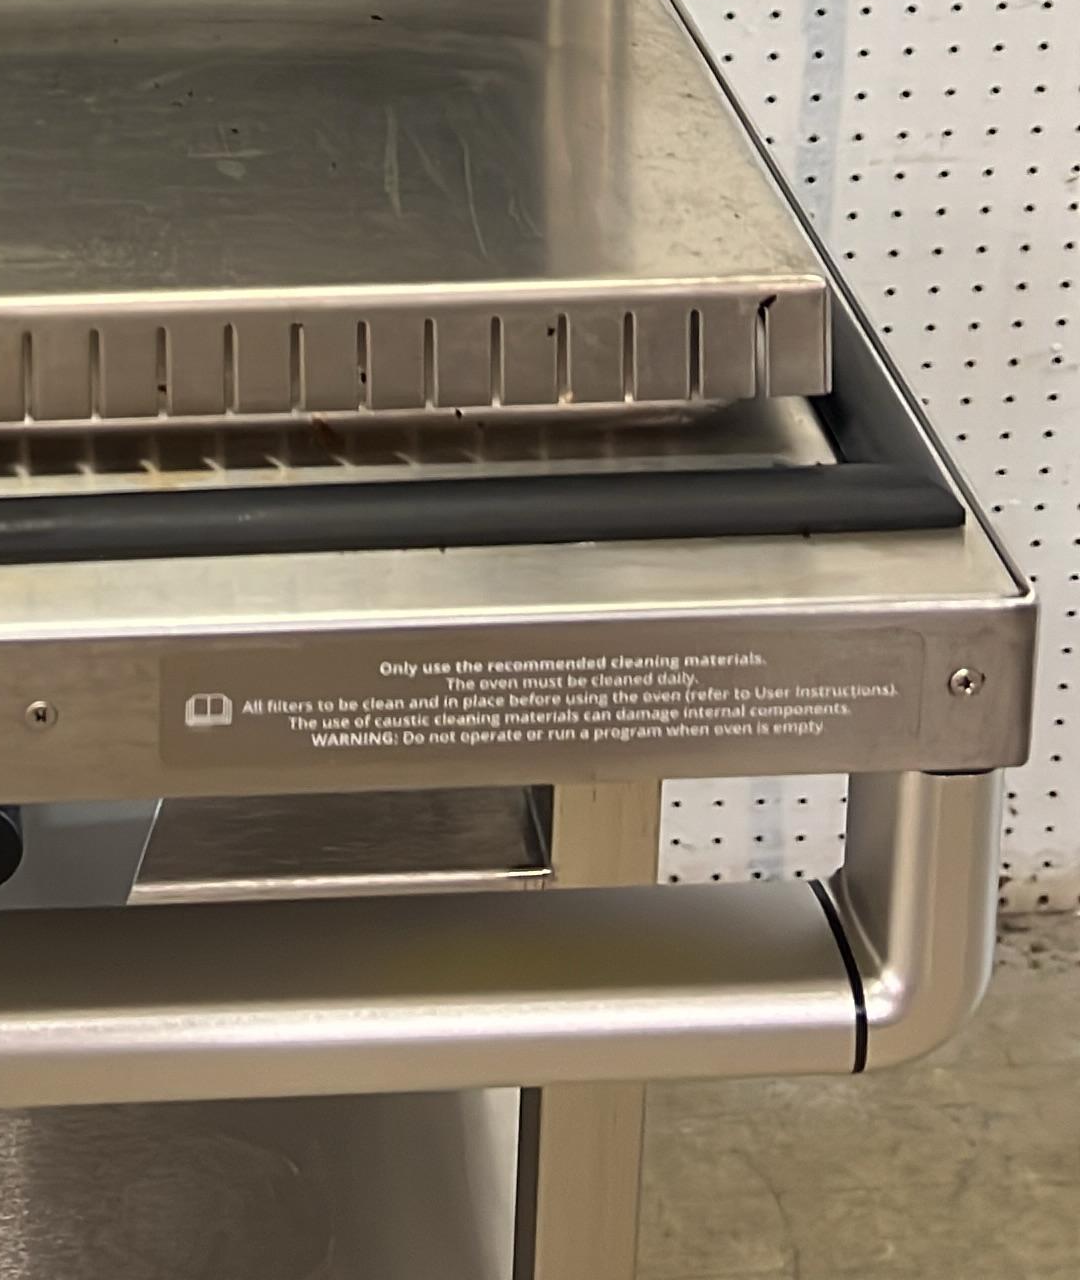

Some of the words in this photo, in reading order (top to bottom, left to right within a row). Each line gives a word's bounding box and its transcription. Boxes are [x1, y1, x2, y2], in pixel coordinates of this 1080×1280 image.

[380, 661, 417, 678] Only
[422, 662, 451, 675] use
[456, 660, 483, 674] the
[487, 656, 607, 673] recommended
[611, 654, 680, 671] cleaning
[684, 651, 767, 667] materials.
[446, 677, 476, 691] The
[480, 677, 518, 690] oven
[523, 676, 563, 689] must
[568, 674, 588, 688] be
[591, 672, 653, 687] cleaned
[657, 671, 699, 688] daily.
[242, 699, 263, 714] All
[267, 698, 313, 714] filters
[318, 699, 334, 713] to
[339, 697, 358, 712] be
[363, 696, 405, 711] clean
[409, 695, 439, 710] and
[443, 695, 459, 709] in
[462, 693, 505, 711] place
[509, 691, 561, 708] before
[566, 691, 609, 708] using
[612, 689, 638, 704] the
[642, 690, 681, 703] oven
[685, 687, 729, 704] (refer
[734, 687, 751, 701] to
[755, 686, 790, 700] User
[289, 715, 317, 730] The
[322, 717, 349, 730] use
[354, 714, 371, 728] of
[374, 712, 430, 728] caustic
[434, 711, 500, 728] cleaning
[504, 709, 579, 725] materials
[583, 709, 611, 722] can
[616, 706, 679, 723] damage
[683, 704, 745, 720] internal
[749, 702, 851, 719] components.
[311, 731, 399, 748] WARNING:
[403, 731, 425, 746] Do
[429, 730, 456, 745] not
[460, 729, 522, 746] operate
[526, 730, 544, 742] or
[548, 729, 575, 741] run
[580, 728, 590, 740] a
[593, 724, 663, 742] program
[666, 722, 709, 737] when
[714, 724, 752, 736] oven
[756, 721, 770, 735] is
